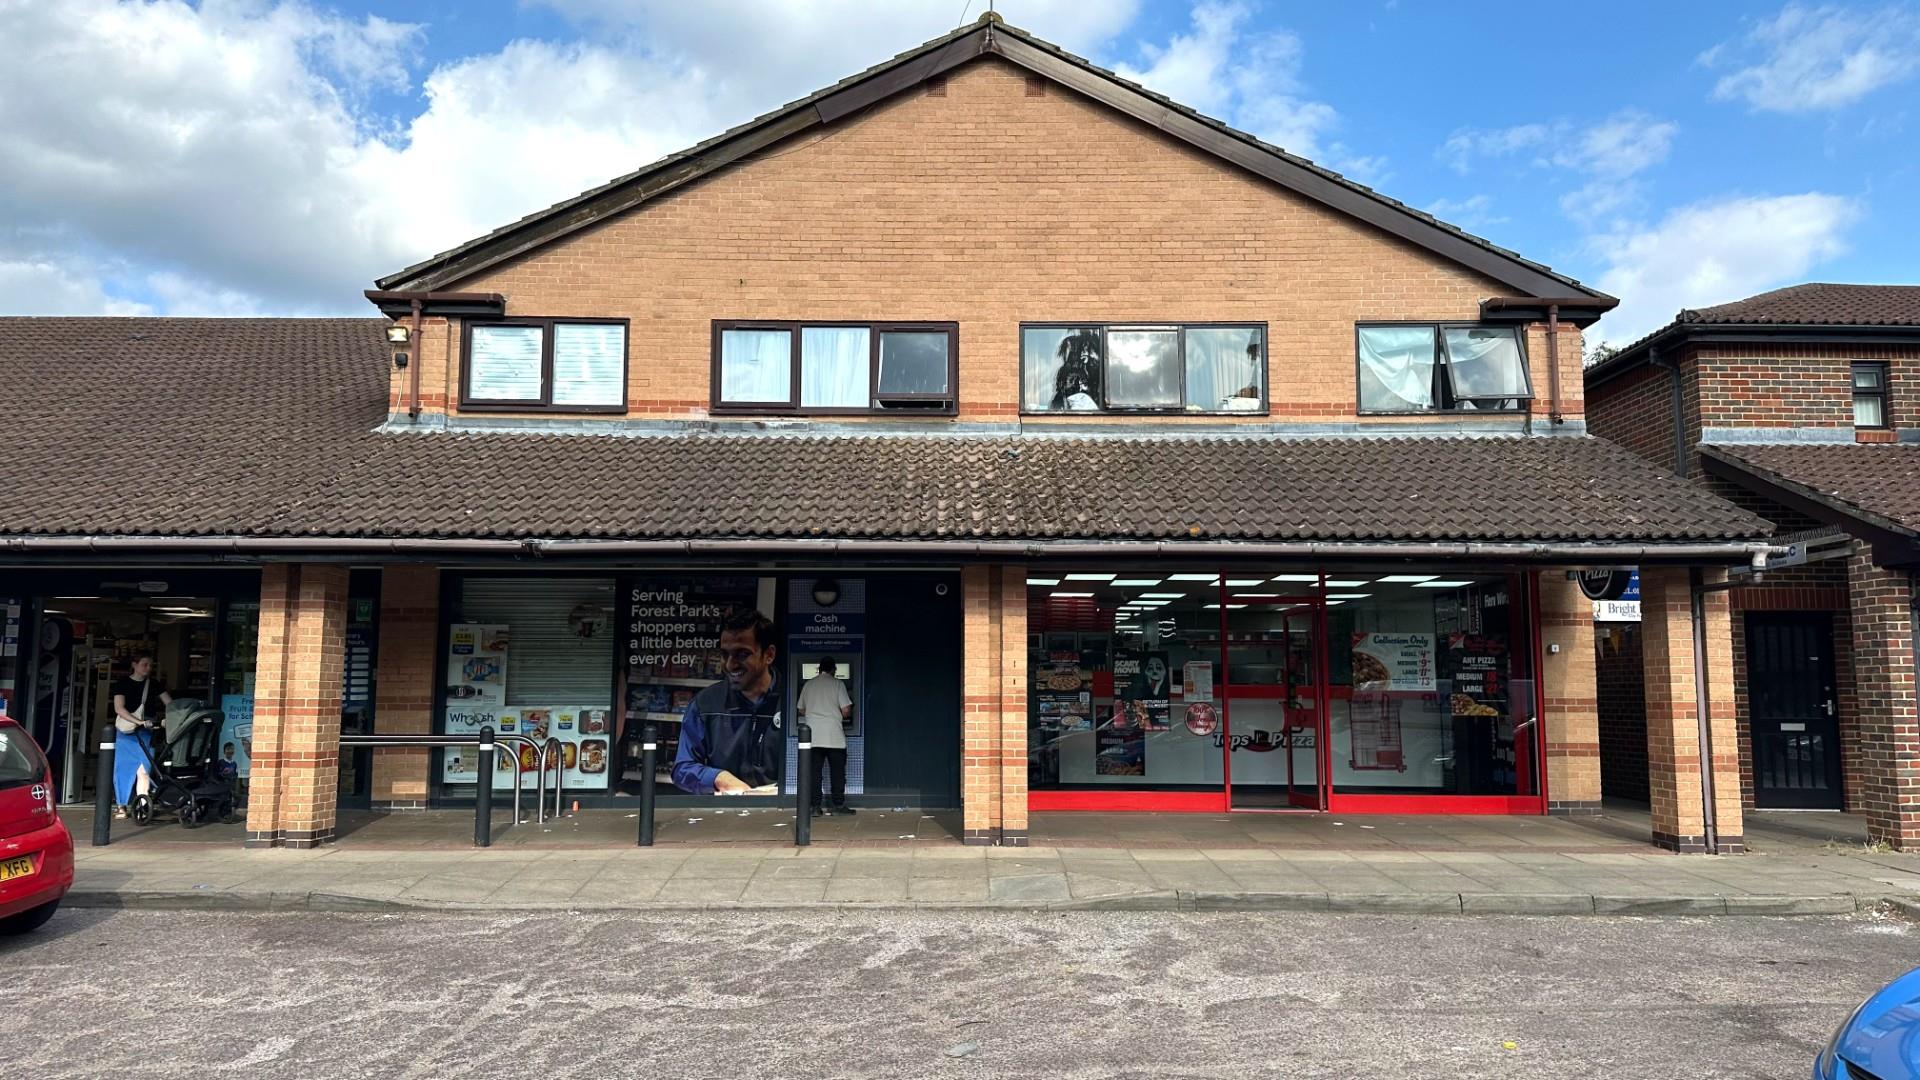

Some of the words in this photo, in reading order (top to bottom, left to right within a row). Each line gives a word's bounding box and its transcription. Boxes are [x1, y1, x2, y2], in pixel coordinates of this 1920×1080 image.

[632, 589, 684, 604] Serving
[631, 605, 675, 617] Forest
[679, 605, 720, 617] Park's
[1608, 602, 1636, 616] Bright
[814, 614, 838, 623] Cash
[630, 621, 697, 635] shoppers
[805, 624, 847, 633] machine
[630, 639, 639, 648] a
[641, 637, 672, 648] little
[676, 636, 720, 648] better
[1373, 635, 1408, 645] Collection
[1410, 635, 1428, 648] Only
[629, 654, 669, 667] every
[670, 652, 697, 667] day
[1114, 660, 1140, 668] SCARY
[1477, 656, 1496, 664] PIZZA
[1456, 672, 1483, 680] MEDIUM
[1462, 684, 1483, 692] LARGE
[1213, 731, 1250, 751] Tps
[5, 860, 29, 877] XFG
